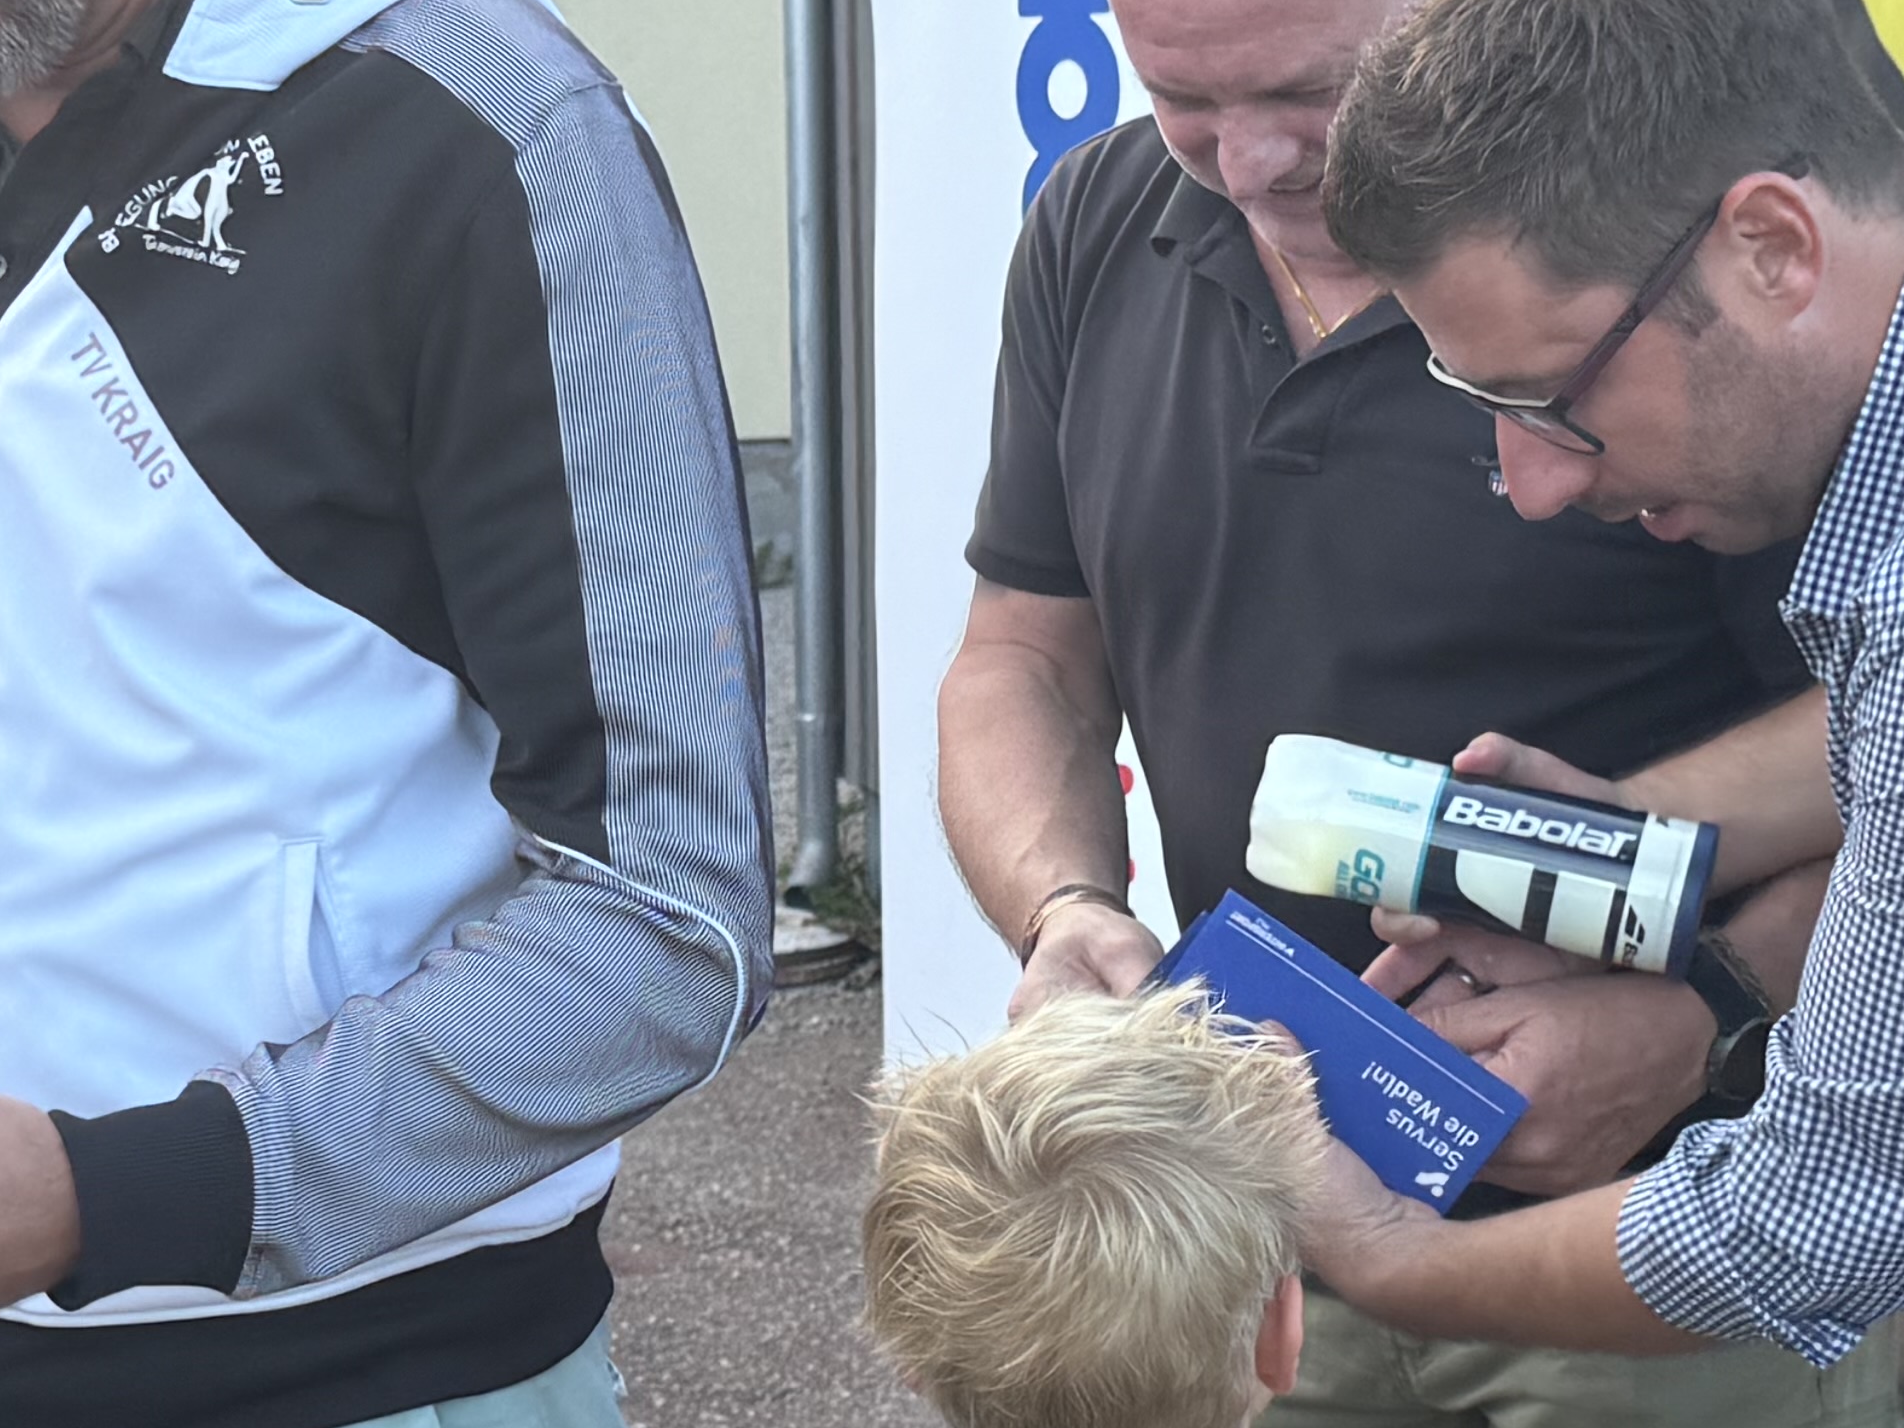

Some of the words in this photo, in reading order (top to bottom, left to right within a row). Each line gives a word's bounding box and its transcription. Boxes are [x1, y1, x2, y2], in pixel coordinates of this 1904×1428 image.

[71, 332, 113, 378] TV
[91, 376, 175, 490] KRAIG
[1361, 1061, 1441, 1127] Wadln!
[1385, 1108, 1464, 1171] Servus
[1443, 1116, 1480, 1147] die
